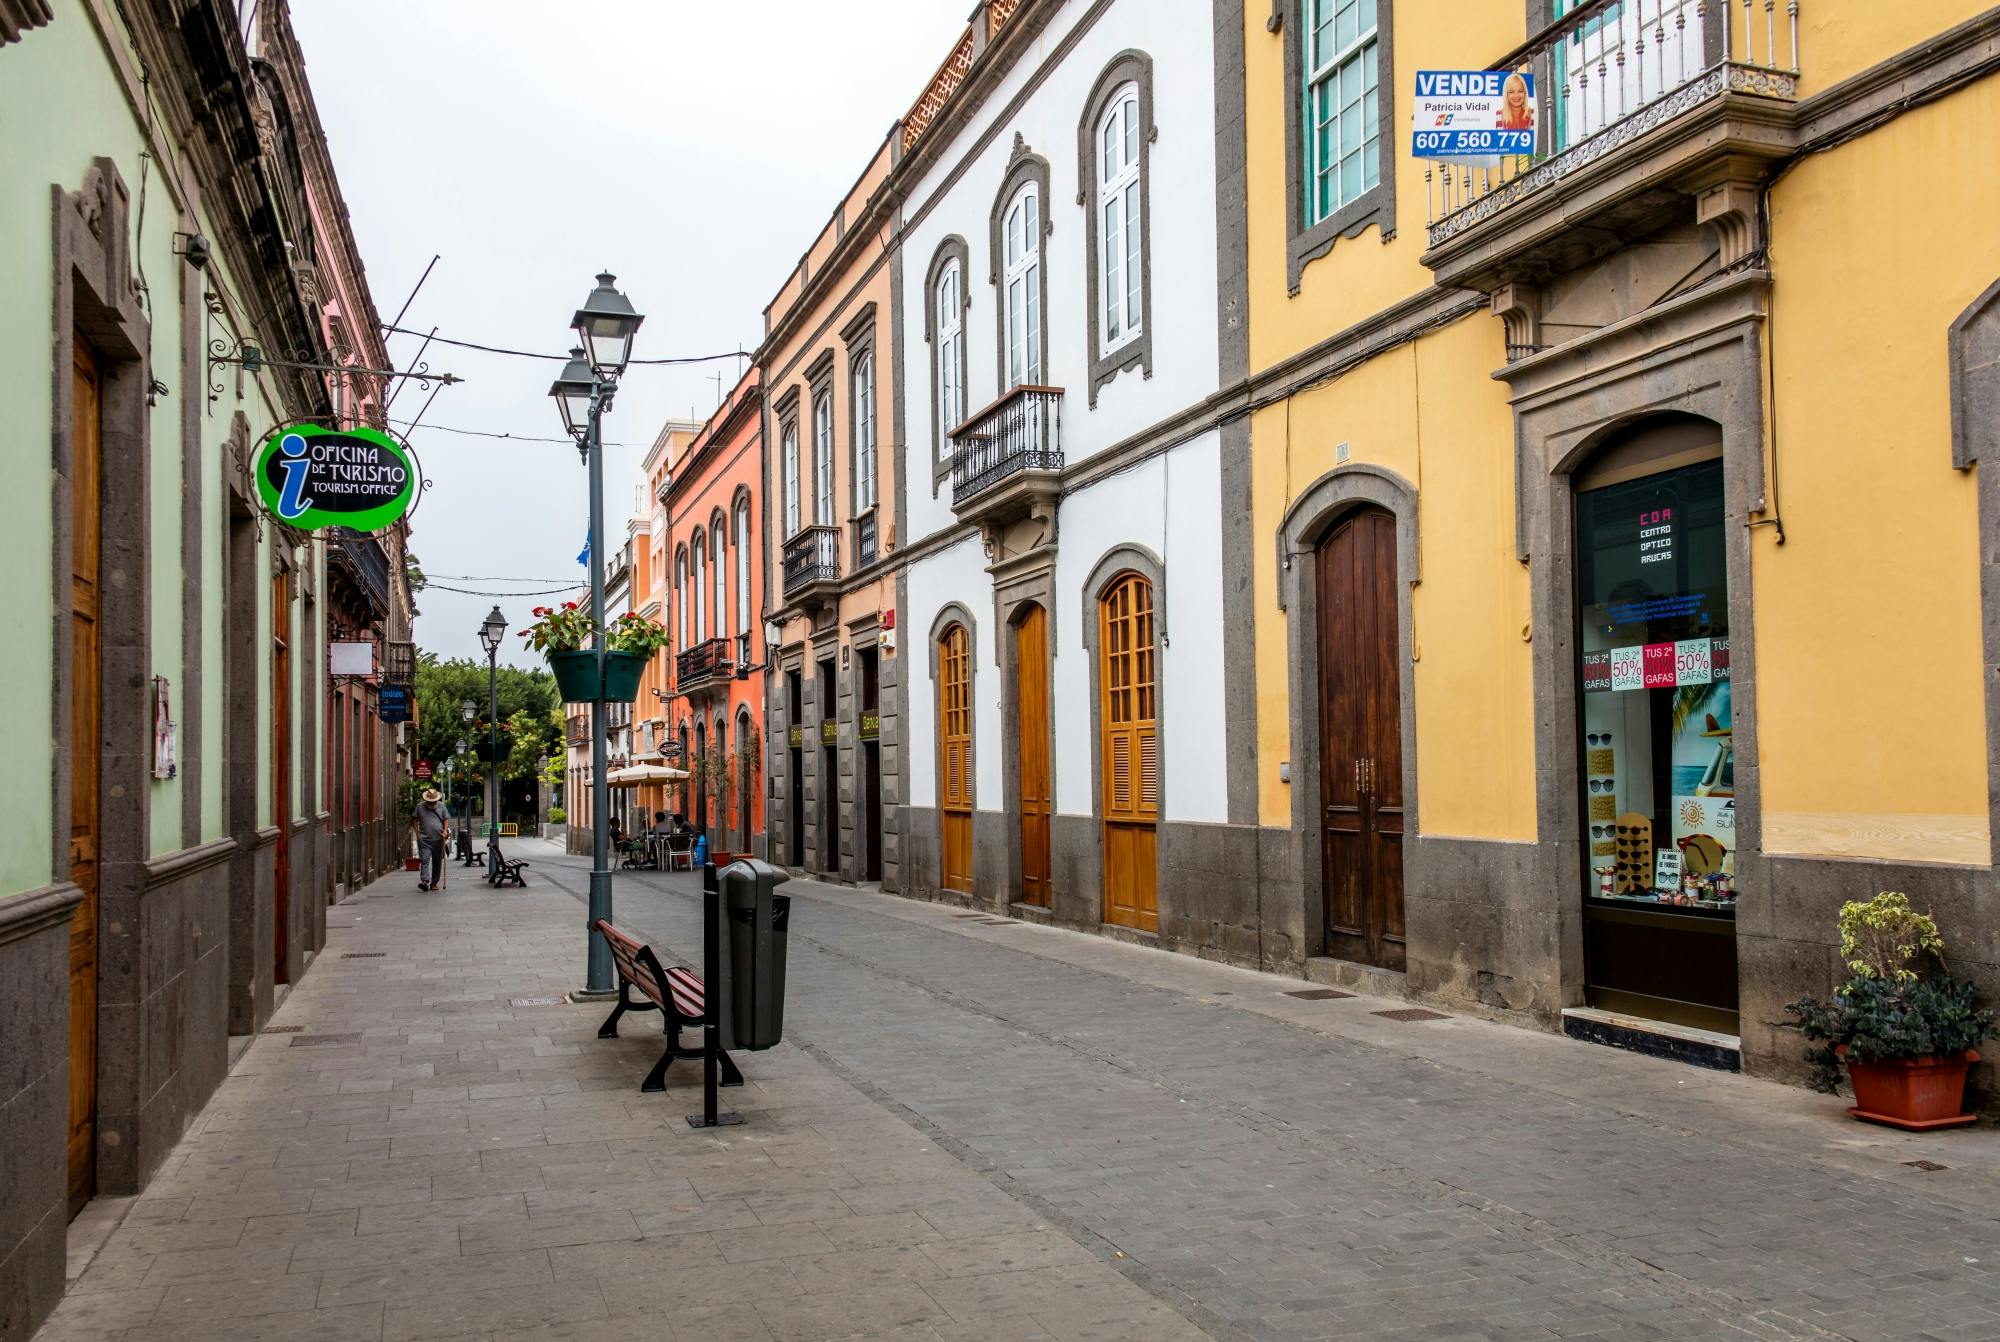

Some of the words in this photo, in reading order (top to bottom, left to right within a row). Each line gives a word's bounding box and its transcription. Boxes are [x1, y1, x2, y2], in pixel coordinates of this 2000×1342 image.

[1418, 74, 1499, 95] VENDE
[1424, 102, 1462, 112] Patricia
[1465, 102, 1490, 111] Vidal
[1416, 132, 1451, 149] 607
[1457, 132, 1491, 148] 560
[1497, 132, 1531, 148] 779
[311, 445, 379, 464] OFICINA
[312, 463, 326, 475] DE
[329, 464, 406, 483] TURISMO
[312, 482, 359, 494] TOURISM
[361, 484, 397, 496] OFFICE
[1640, 525, 1671, 539] CENTRO
[1640, 538, 1672, 551] OPTICO
[1641, 551, 1672, 564] ARUCAS
[1645, 648, 1662, 658] TUS
[1679, 644, 1696, 654] TUS
[1584, 655, 1599, 665] TUS
[1614, 651, 1630, 661] TUS
[1677, 652, 1709, 672] 50%
[1613, 660, 1642, 677] 50%
[1678, 669, 1708, 681] GAFAS
[1584, 679, 1610, 689] GAFAS
[1614, 675, 1640, 687] GAFAS
[1645, 673, 1674, 684] GAFAS
